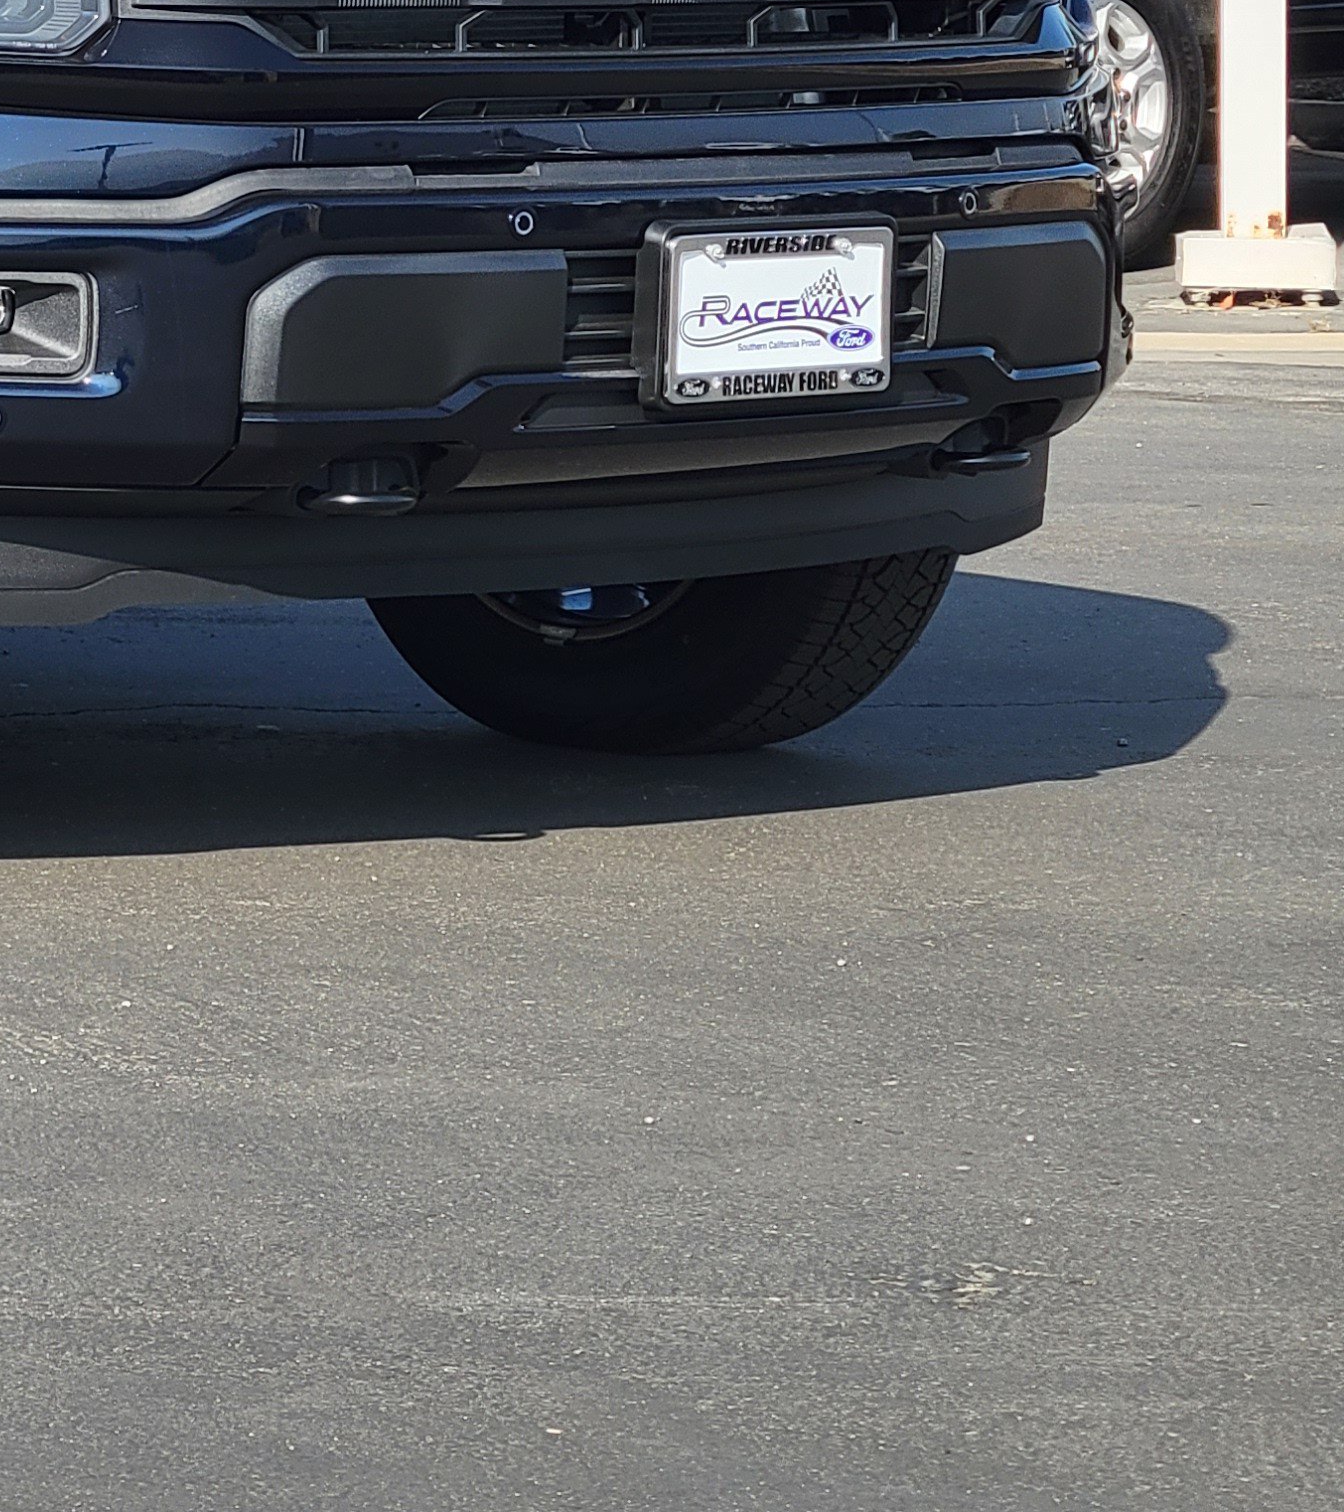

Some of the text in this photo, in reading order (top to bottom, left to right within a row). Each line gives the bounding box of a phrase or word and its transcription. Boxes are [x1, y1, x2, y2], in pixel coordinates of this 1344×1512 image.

[725, 234, 837, 255] RIVERSIDE
[698, 294, 874, 328] RACEWAY
[738, 338, 821, 352] Southern California Proud
[836, 329, 867, 347] Ford
[723, 370, 838, 396] RACEWAY FORD
